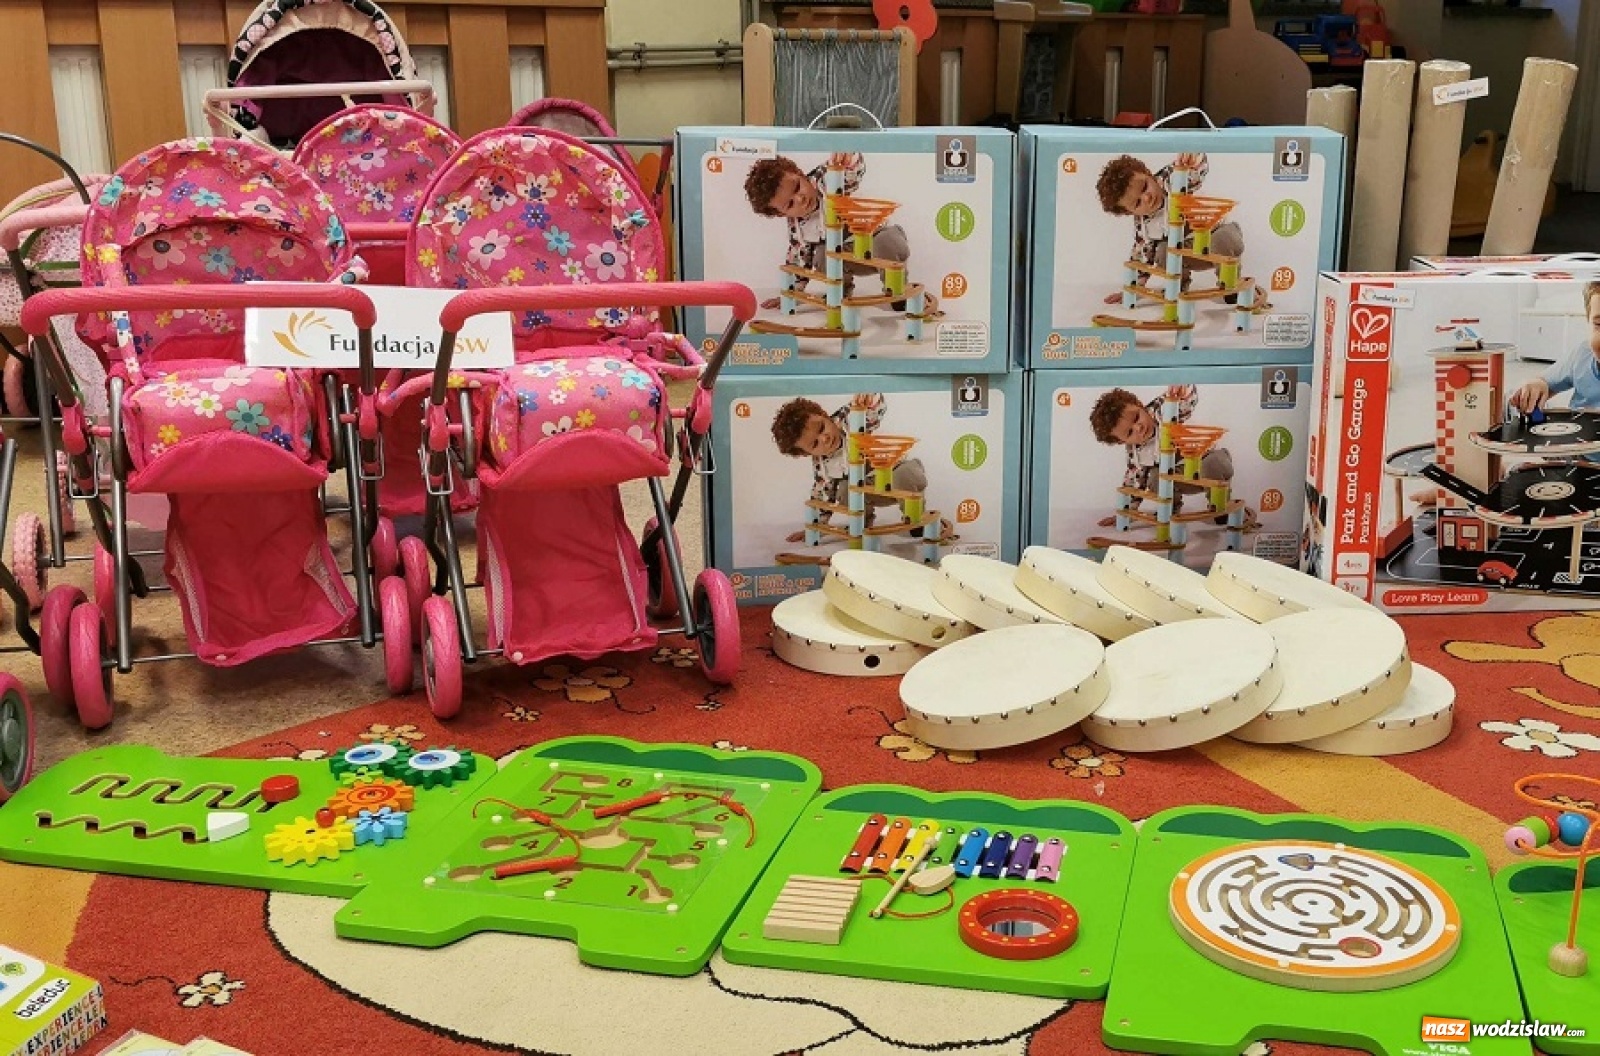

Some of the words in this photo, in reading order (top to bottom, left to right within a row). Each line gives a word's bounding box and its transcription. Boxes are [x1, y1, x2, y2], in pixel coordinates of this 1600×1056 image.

[945, 276, 963, 289] 89
[330, 333, 436, 359] Fudacja
[452, 336, 490, 355] SW
[1350, 340, 1387, 354] Hape
[1347, 378, 1368, 440] Garage
[1346, 444, 1360, 467] Go
[1345, 471, 1358, 504] and
[1264, 491, 1280, 504] 89
[960, 502, 977, 514] 89
[1340, 507, 1356, 545] Park
[1391, 593, 1417, 603] Love
[1420, 592, 1445, 604] Play
[1447, 591, 1479, 602] Learn
[714, 812, 730, 822] 6
[521, 839, 540, 850] 4
[689, 840, 708, 851] 5
[552, 876, 574, 890] 2
[626, 884, 639, 896] 1
